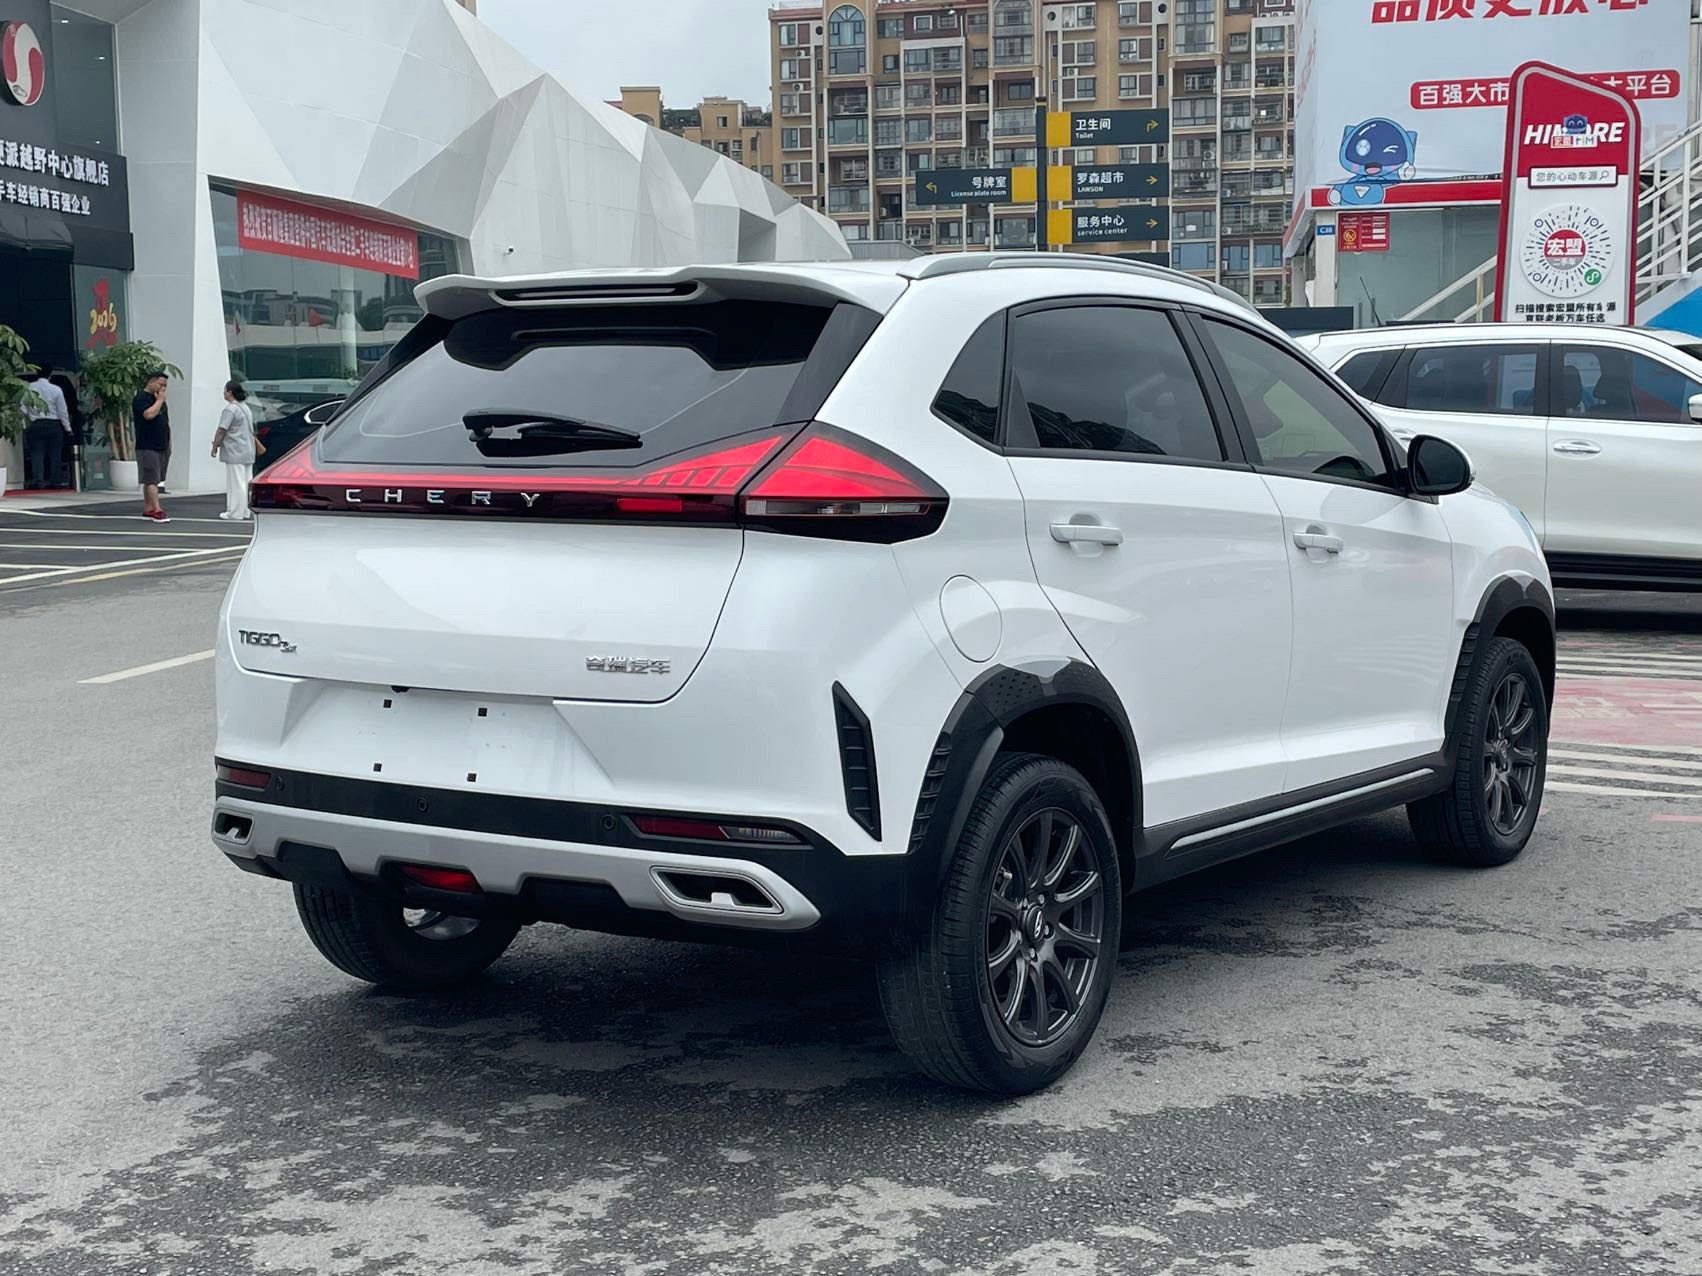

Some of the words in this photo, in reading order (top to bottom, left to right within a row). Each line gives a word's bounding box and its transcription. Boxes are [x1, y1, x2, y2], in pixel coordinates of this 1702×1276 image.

[1418, 82, 1509, 106] 百强大市
[1075, 118, 1111, 131] 卫生间
[971, 176, 1007, 189] 号牌室
[1077, 171, 1125, 185] 罗森超市
[1535, 170, 1599, 182] 您的心动车源
[1077, 215, 1125, 228] 服务中心
[1546, 237, 1584, 256] 宏盟
[345, 488, 540, 508] CHERY
